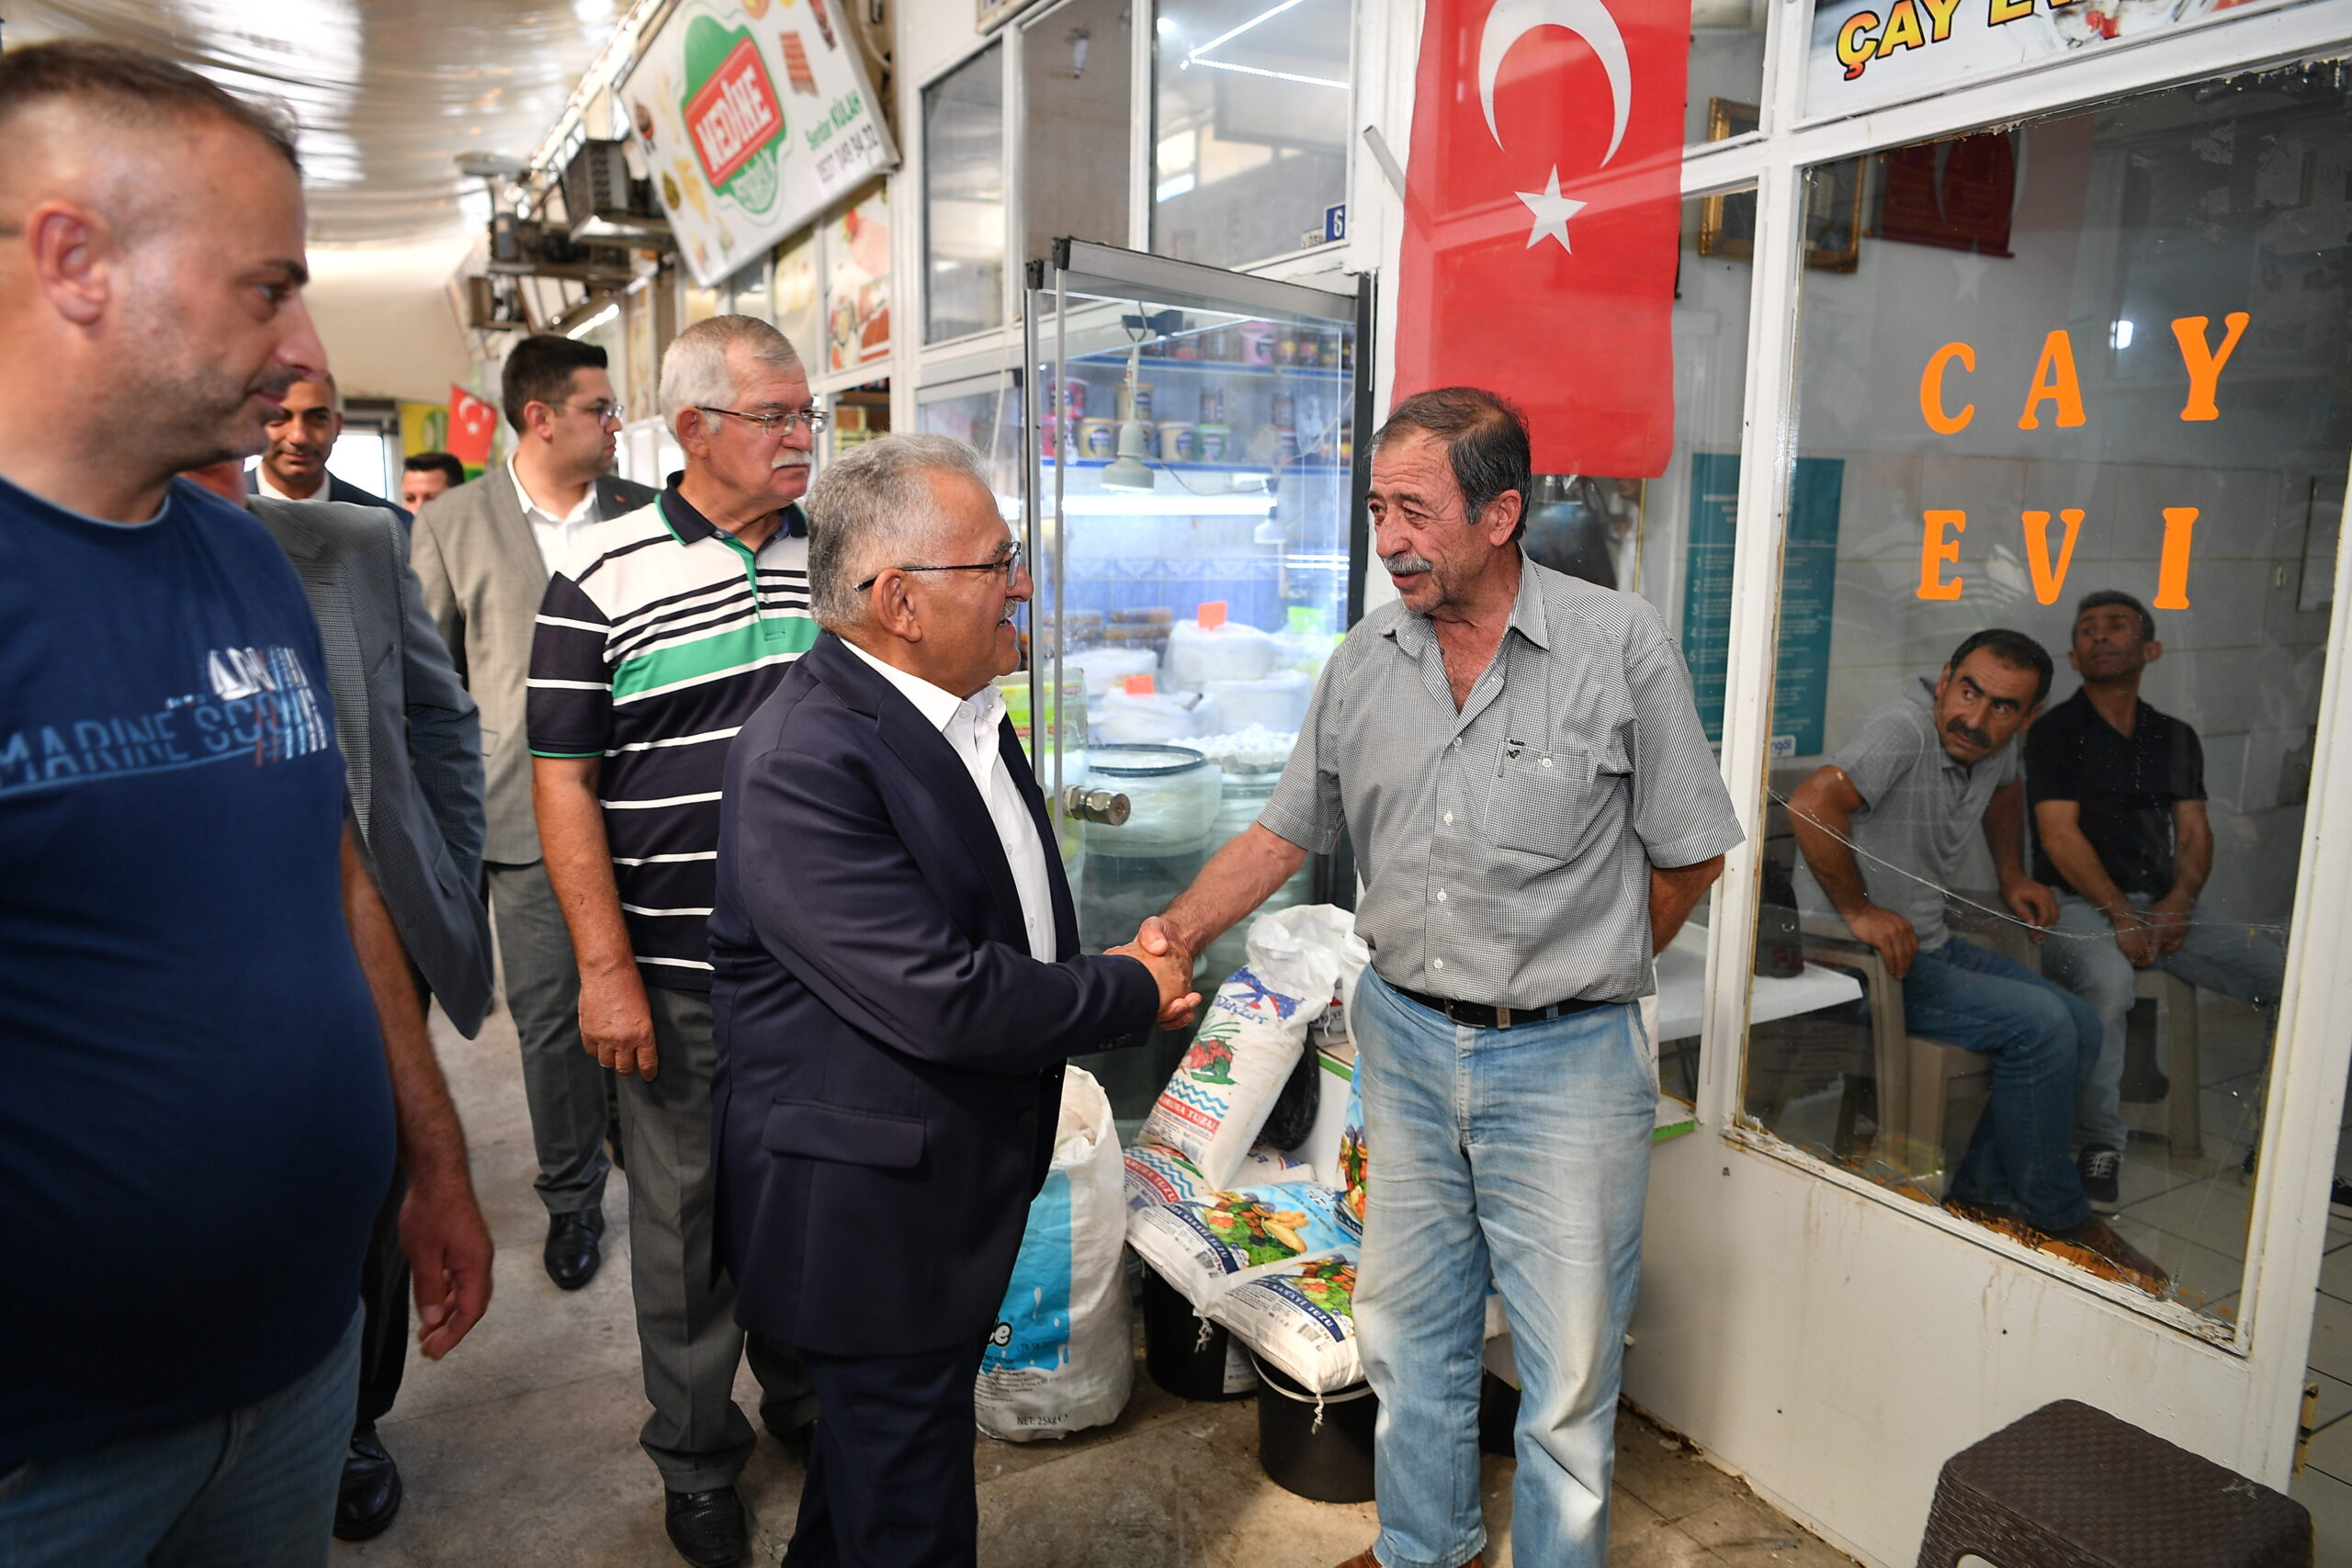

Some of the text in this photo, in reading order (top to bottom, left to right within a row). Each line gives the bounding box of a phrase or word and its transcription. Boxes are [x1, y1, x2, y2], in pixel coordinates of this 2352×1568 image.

[1837, 0, 1963, 81] ÇAY
[1920, 311, 2251, 434] CAY
[1917, 507, 2199, 610] EVI
[0, 710, 189, 784] MARINE
[1307, 1306, 1335, 1327] TUZU
[1017, 1416, 1036, 1426] NET:
